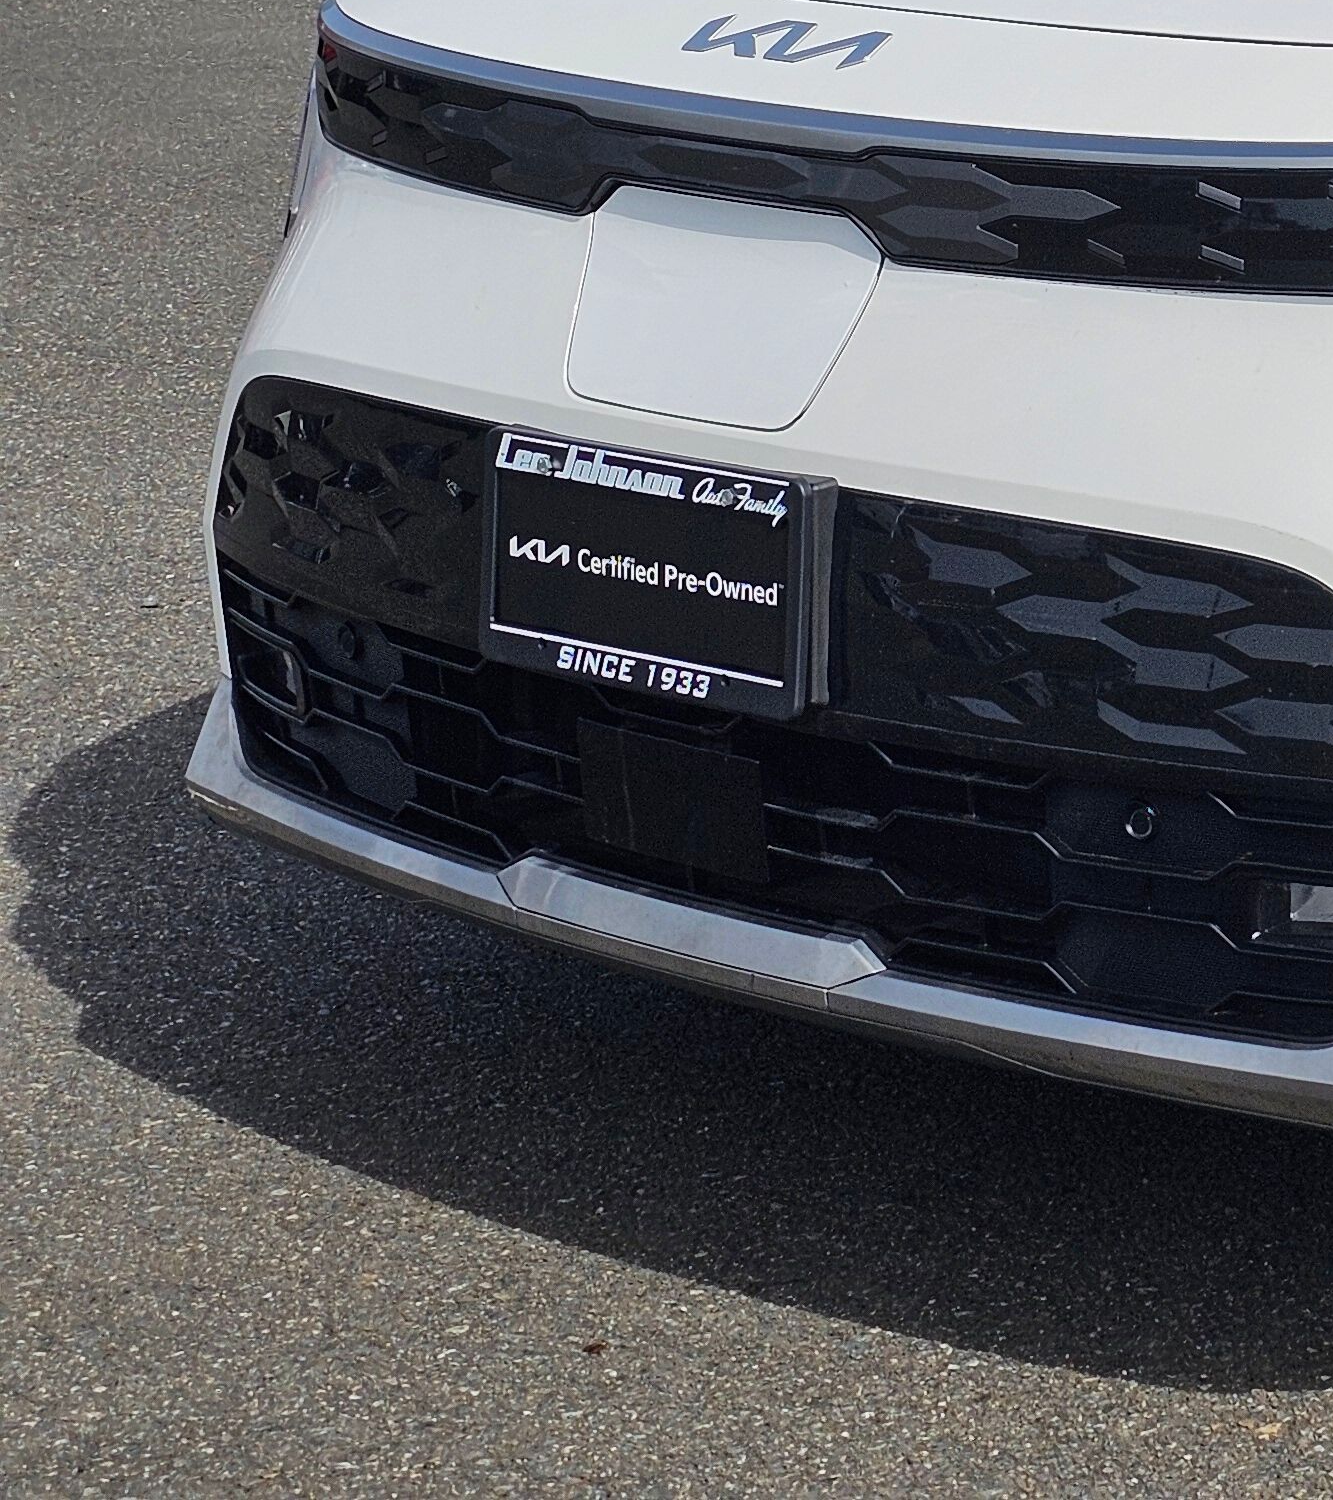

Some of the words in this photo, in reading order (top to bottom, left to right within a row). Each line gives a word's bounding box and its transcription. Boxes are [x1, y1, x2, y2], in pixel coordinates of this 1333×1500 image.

[681, 14, 893, 70] KIA
[554, 444, 685, 499] Johnson
[692, 477, 734, 507] Aut
[734, 483, 788, 528] Family
[510, 535, 570, 567] KIA
[577, 548, 658, 586] Certified
[556, 646, 637, 683] SINCE
[647, 664, 711, 699] 1933
